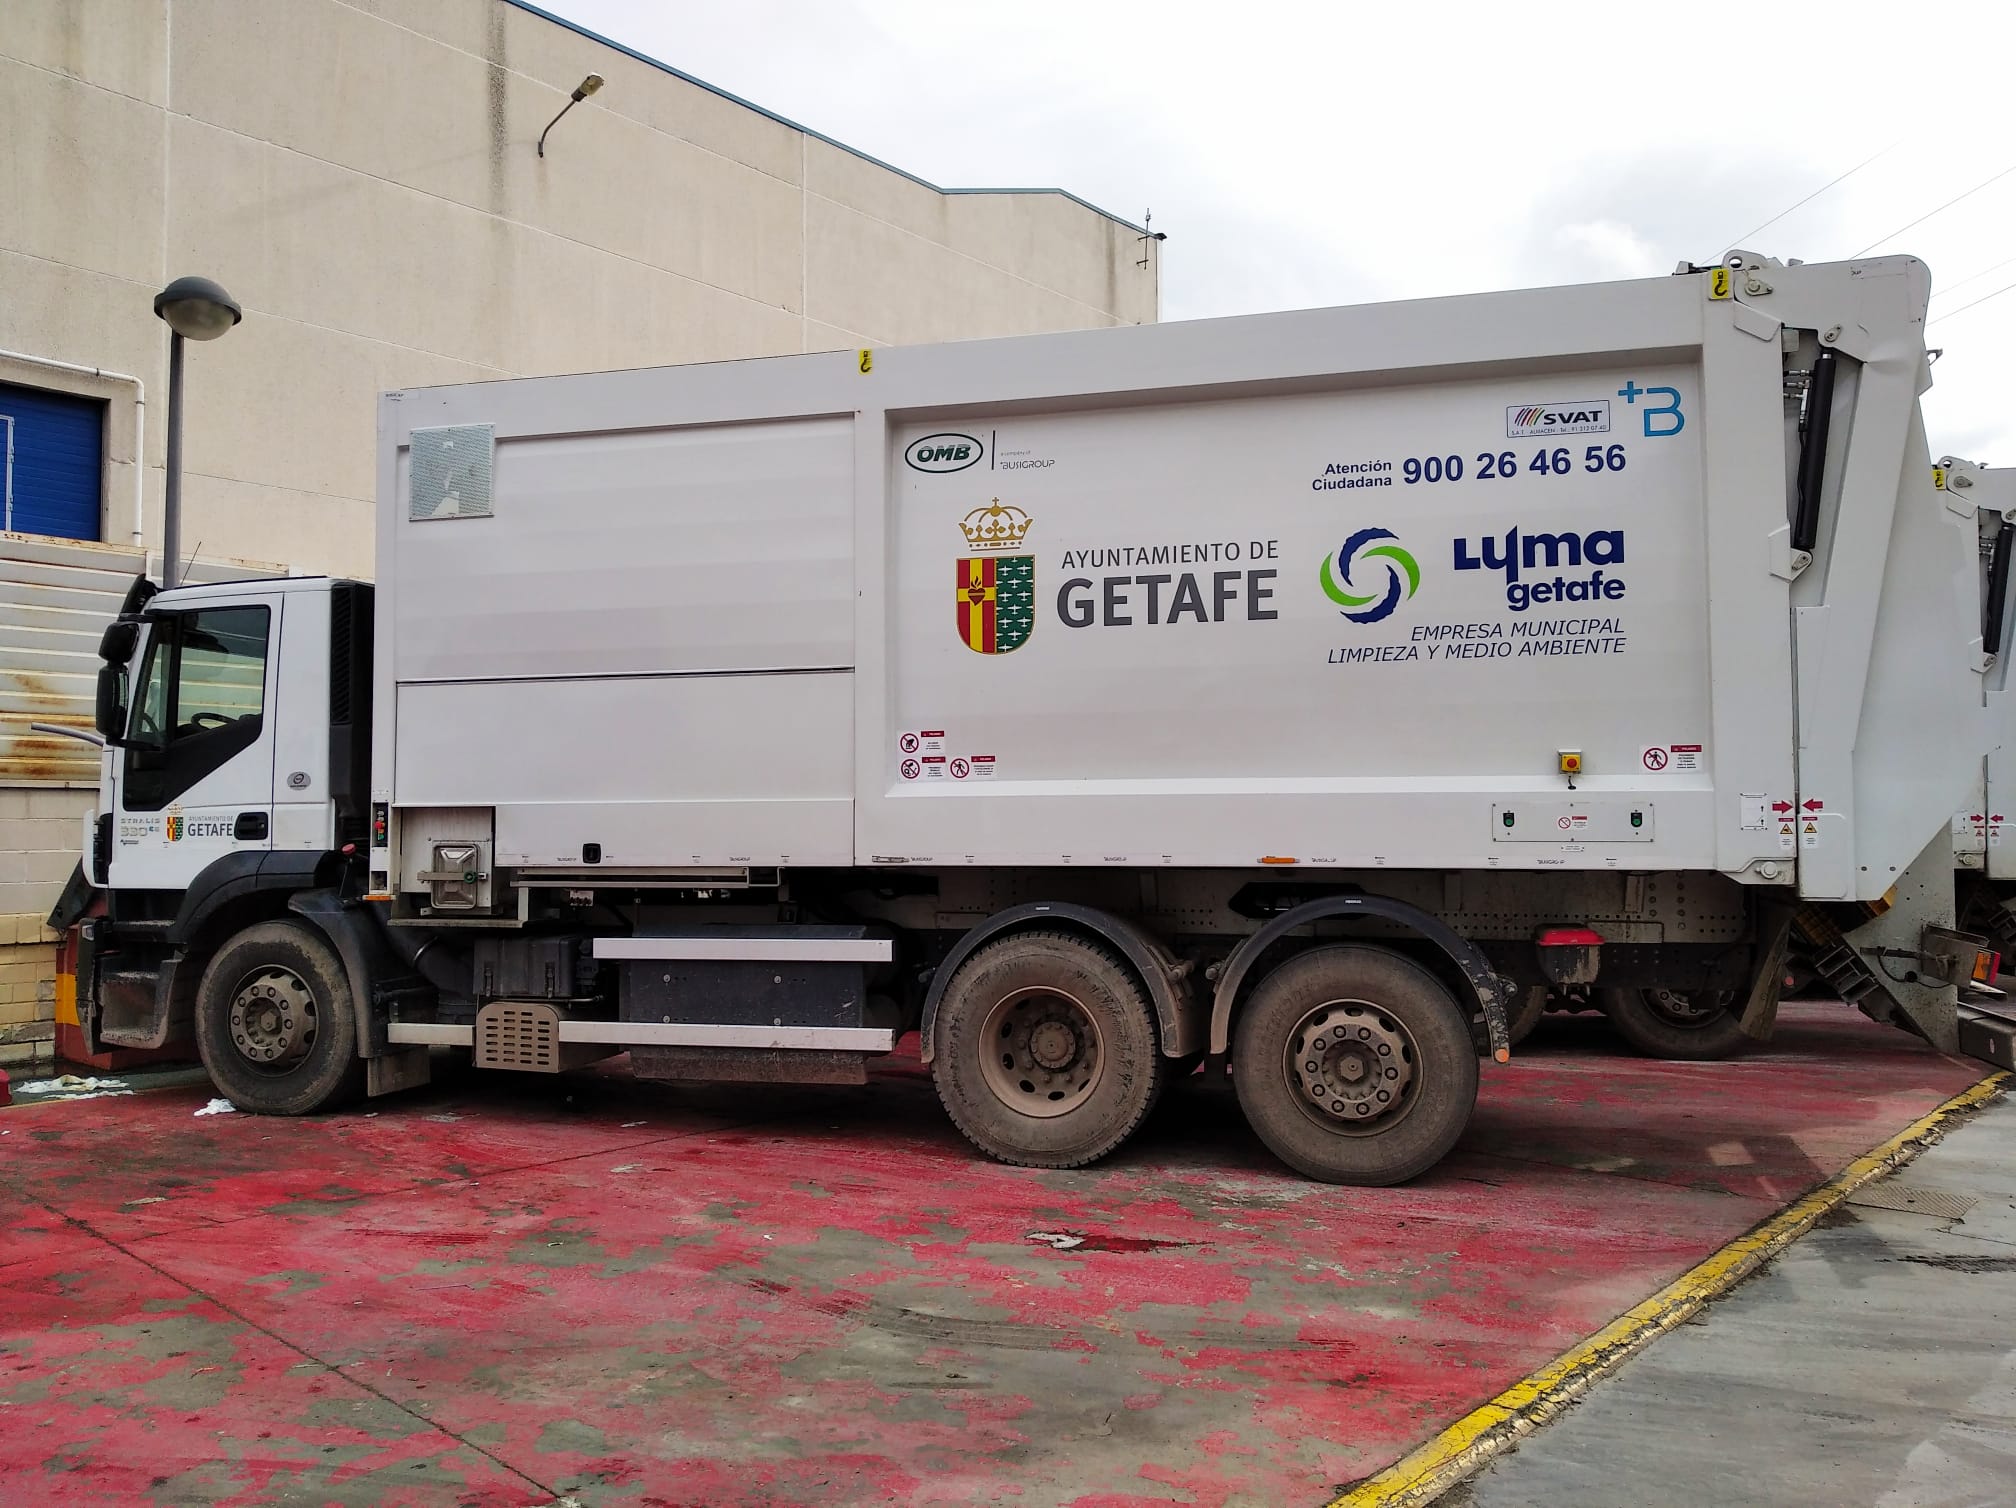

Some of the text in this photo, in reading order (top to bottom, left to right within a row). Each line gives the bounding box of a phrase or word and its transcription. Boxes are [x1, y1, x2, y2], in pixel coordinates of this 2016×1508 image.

[1543, 410, 1603, 425] SVAT
[917, 444, 971, 463] OMB
[1403, 444, 1627, 485] 900 26 46 56
[1324, 459, 1392, 475] Atención
[1312, 475, 1392, 492] Ciudadana
[1061, 540, 1279, 569] AYUNTAMIENTO DE
[1056, 568, 1279, 628] GETAFE
[1506, 570, 1626, 611] getafe
[1411, 618, 1625, 641] EMPRESA MUNICIPAL
[1327, 637, 1627, 664] LIMPIEZA Y MEDIO AMBIENTE
[187, 823, 233, 836] GETAFE
